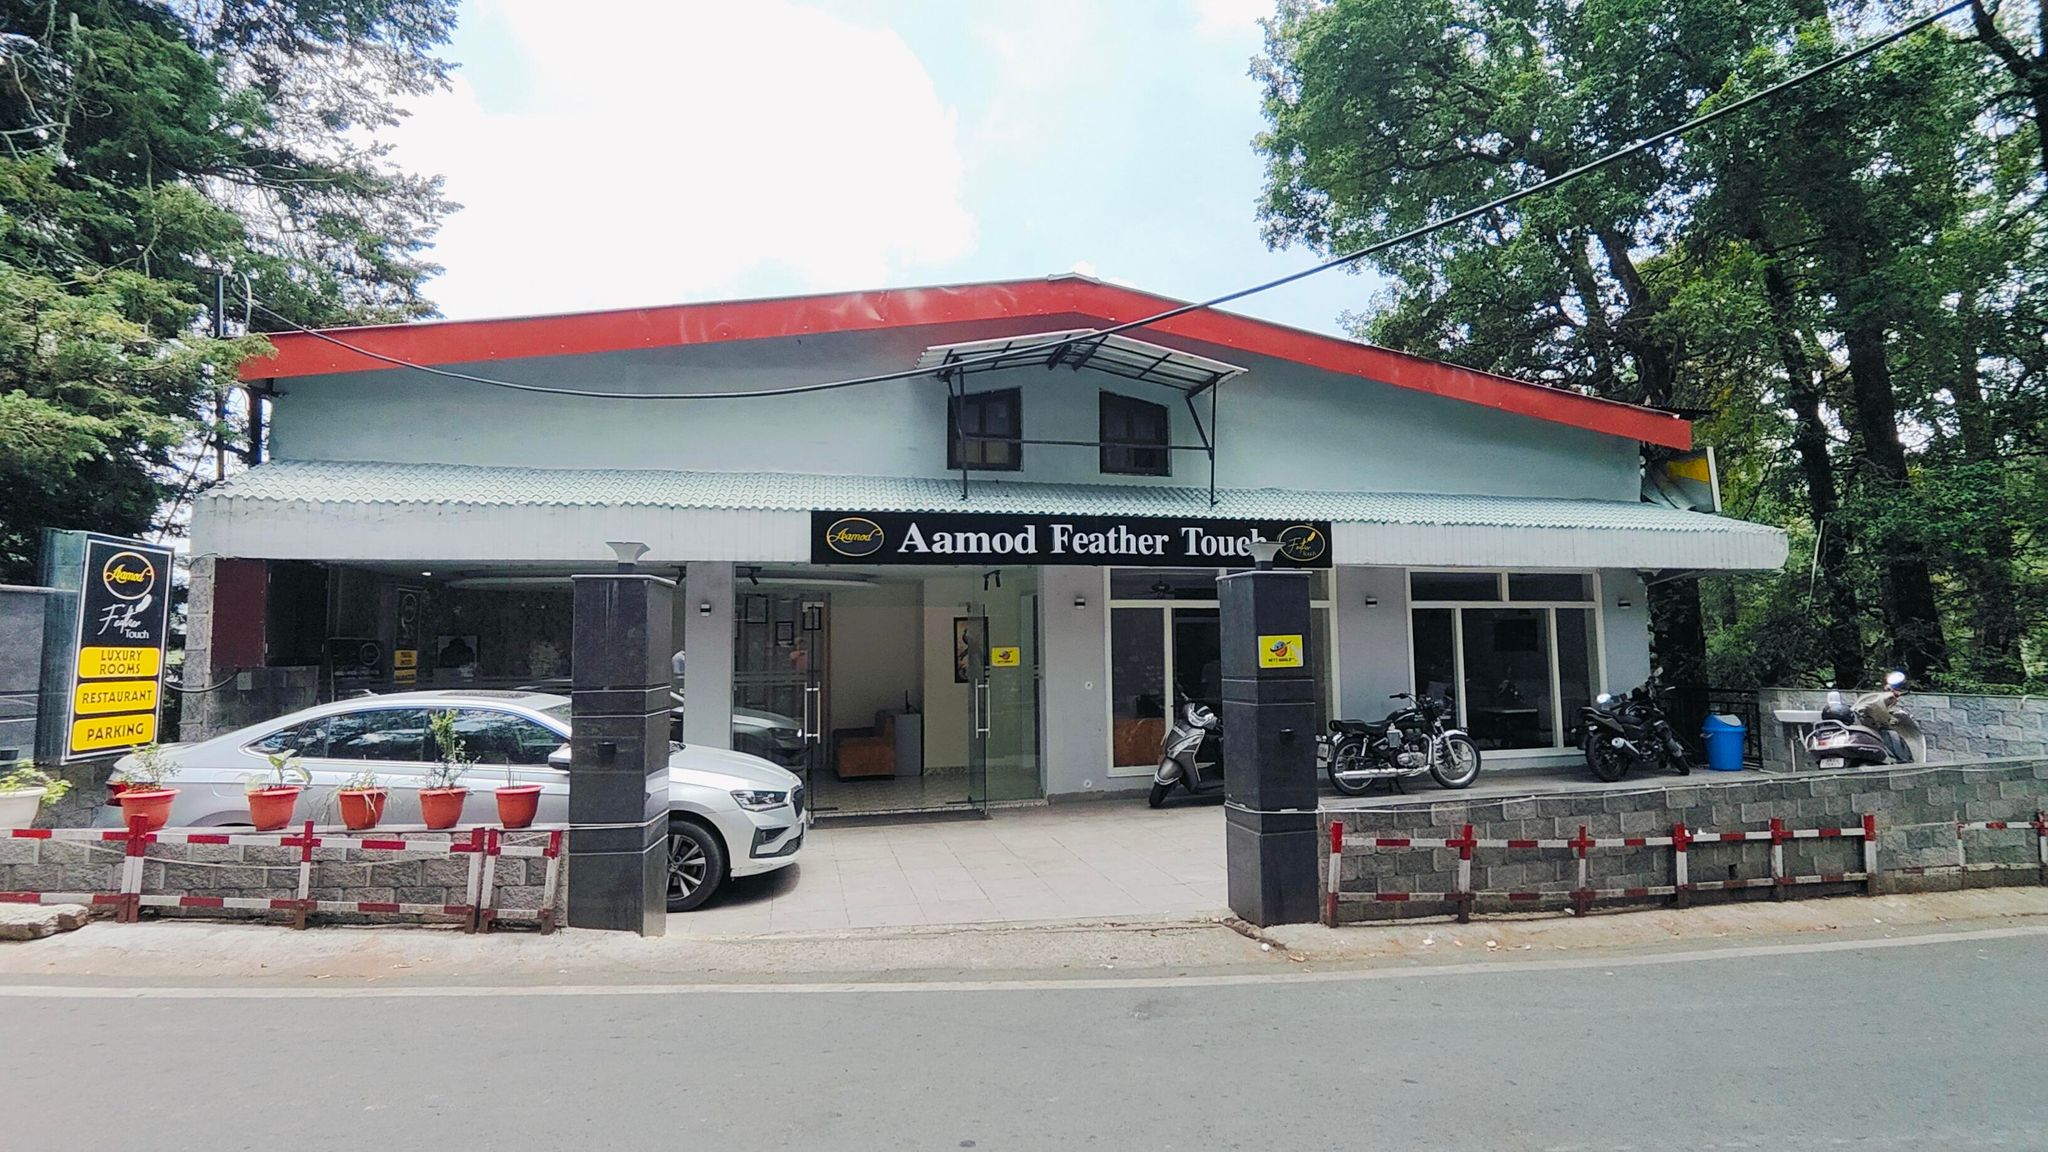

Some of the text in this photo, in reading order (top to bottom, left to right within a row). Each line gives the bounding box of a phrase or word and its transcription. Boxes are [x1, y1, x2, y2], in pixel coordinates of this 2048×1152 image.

[829, 527, 880, 543] Aamod
[897, 522, 1038, 554] Aamod
[1049, 524, 1170, 555] Feather
[105, 563, 152, 584] Aamod
[125, 629, 150, 639] Touch
[101, 650, 142, 661] LUXURY
[100, 664, 141, 675] ROOMS
[82, 690, 153, 704] RESTAURANT
[87, 723, 144, 741] PARKING
